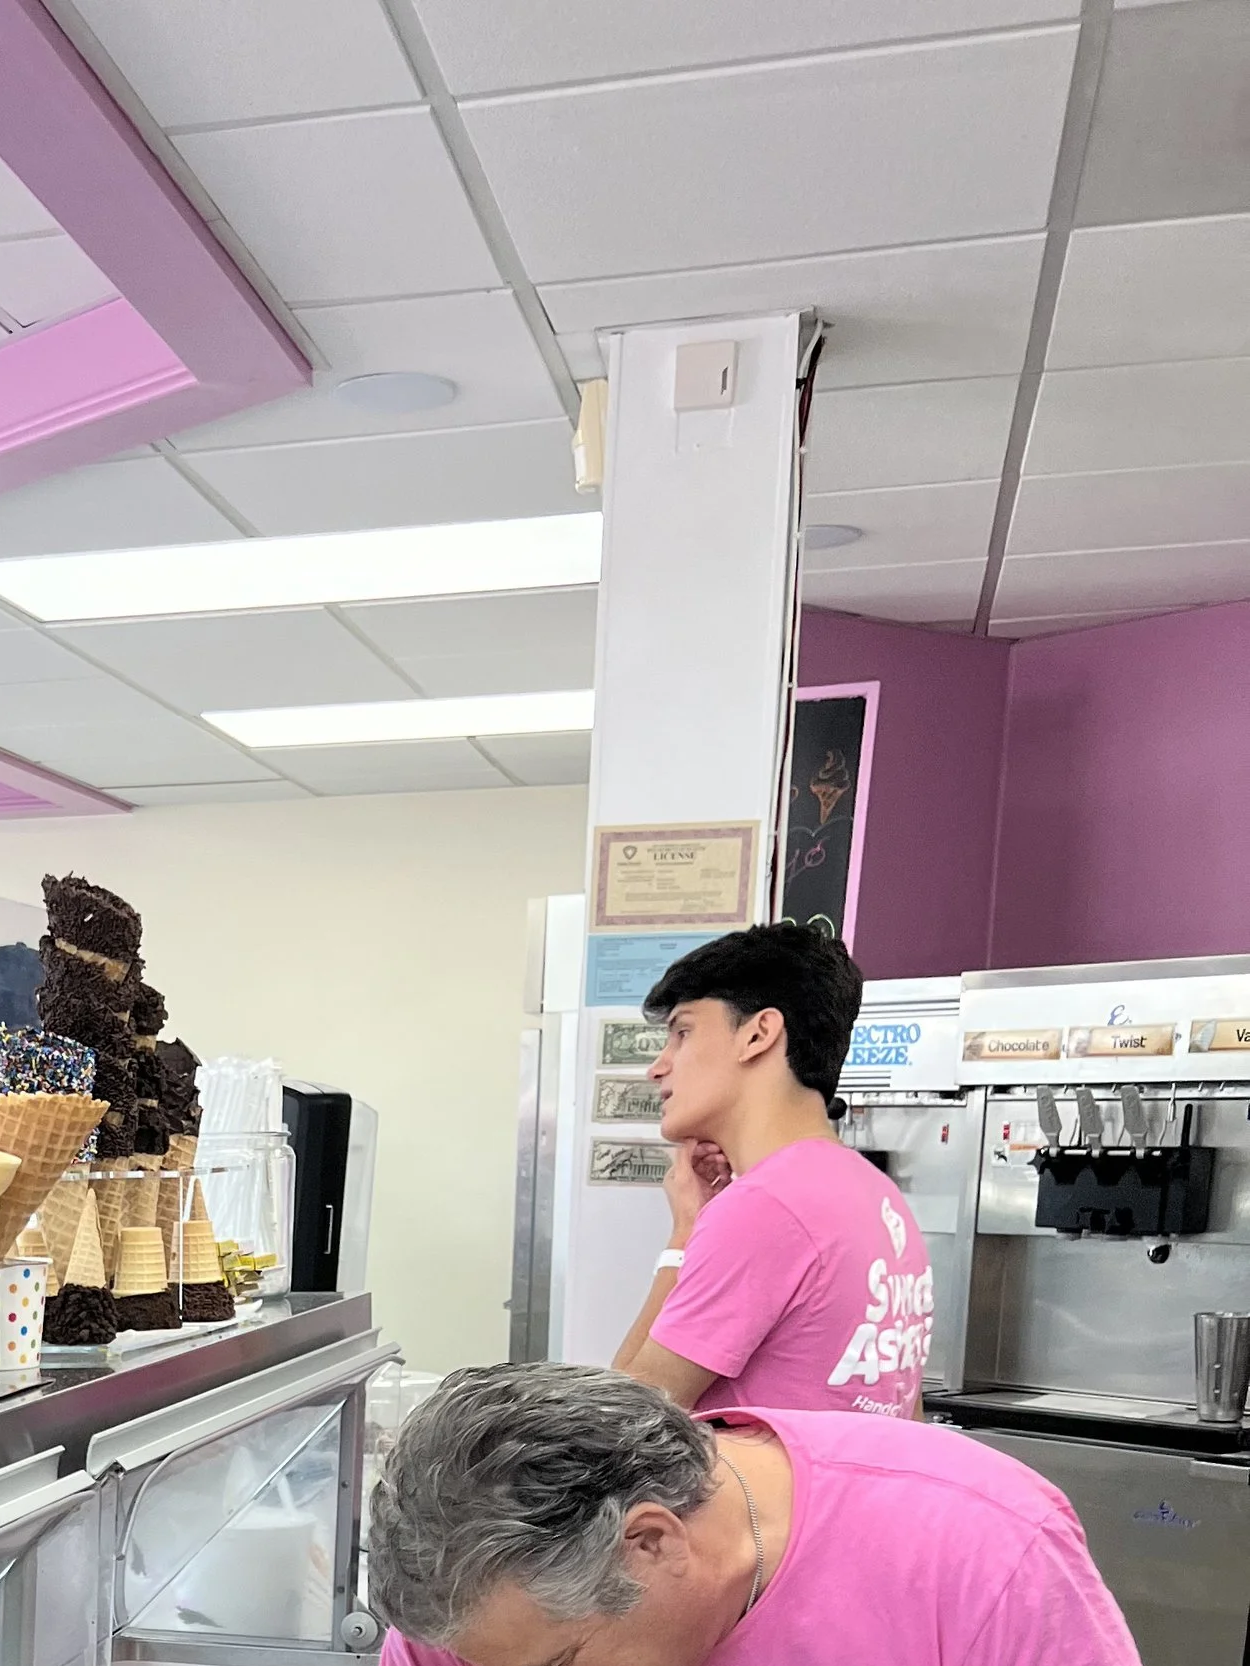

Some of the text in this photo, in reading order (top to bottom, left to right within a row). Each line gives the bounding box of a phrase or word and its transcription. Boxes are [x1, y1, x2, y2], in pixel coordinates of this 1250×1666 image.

[851, 1023, 921, 1045] ECTRO
[1111, 1035, 1147, 1049] Twist
[988, 1039, 1050, 1053] Chocolate
[852, 1394, 904, 1417] Handc
